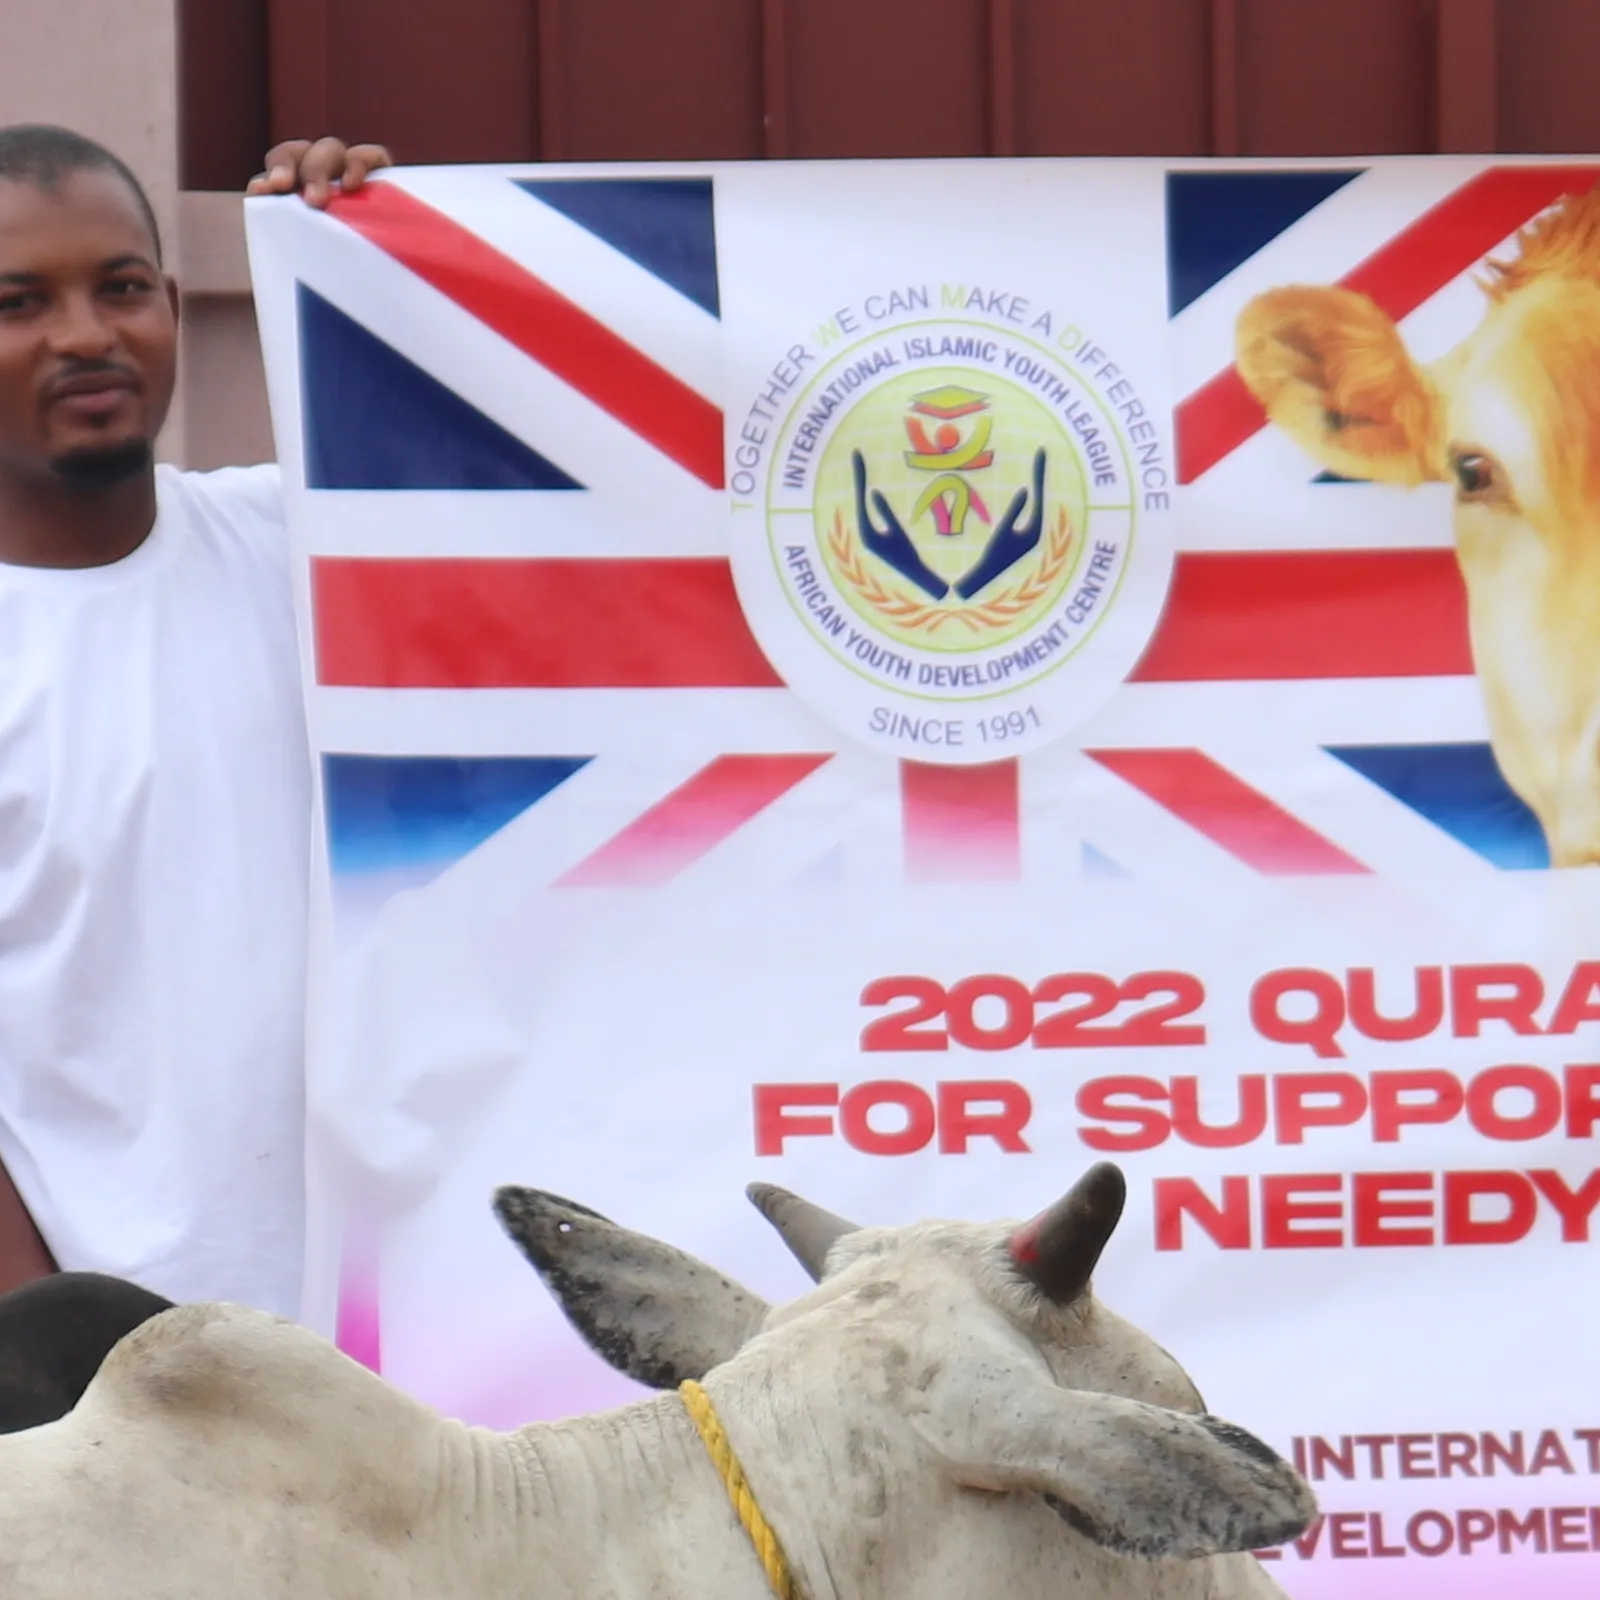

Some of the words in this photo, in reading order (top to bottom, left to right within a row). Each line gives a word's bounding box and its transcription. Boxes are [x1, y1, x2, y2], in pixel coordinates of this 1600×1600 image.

[730, 343, 813, 514] TOGETHER
[811, 307, 861, 348] WE
[864, 284, 929, 321] CAN
[941, 283, 1030, 324] MAKE
[1031, 311, 1053, 337] A
[1057, 325, 1170, 512] DIFFERENCE
[782, 346, 902, 489] INTERNATIONAL
[904, 335, 998, 363] ISLAMIC
[1003, 346, 1069, 405] YOUTH
[1064, 397, 1117, 488] LEAGUE
[784, 543, 846, 638] AFRICAN
[844, 626, 911, 681] YOUTH
[917, 623, 1071, 687] DEVELOPMENT
[1065, 539, 1118, 625] CENTRE
[868, 706, 963, 746] SINCE
[975, 704, 1043, 743] 1991
[859, 970, 1207, 1053] 2022
[752, 1078, 1034, 1157] FOR
